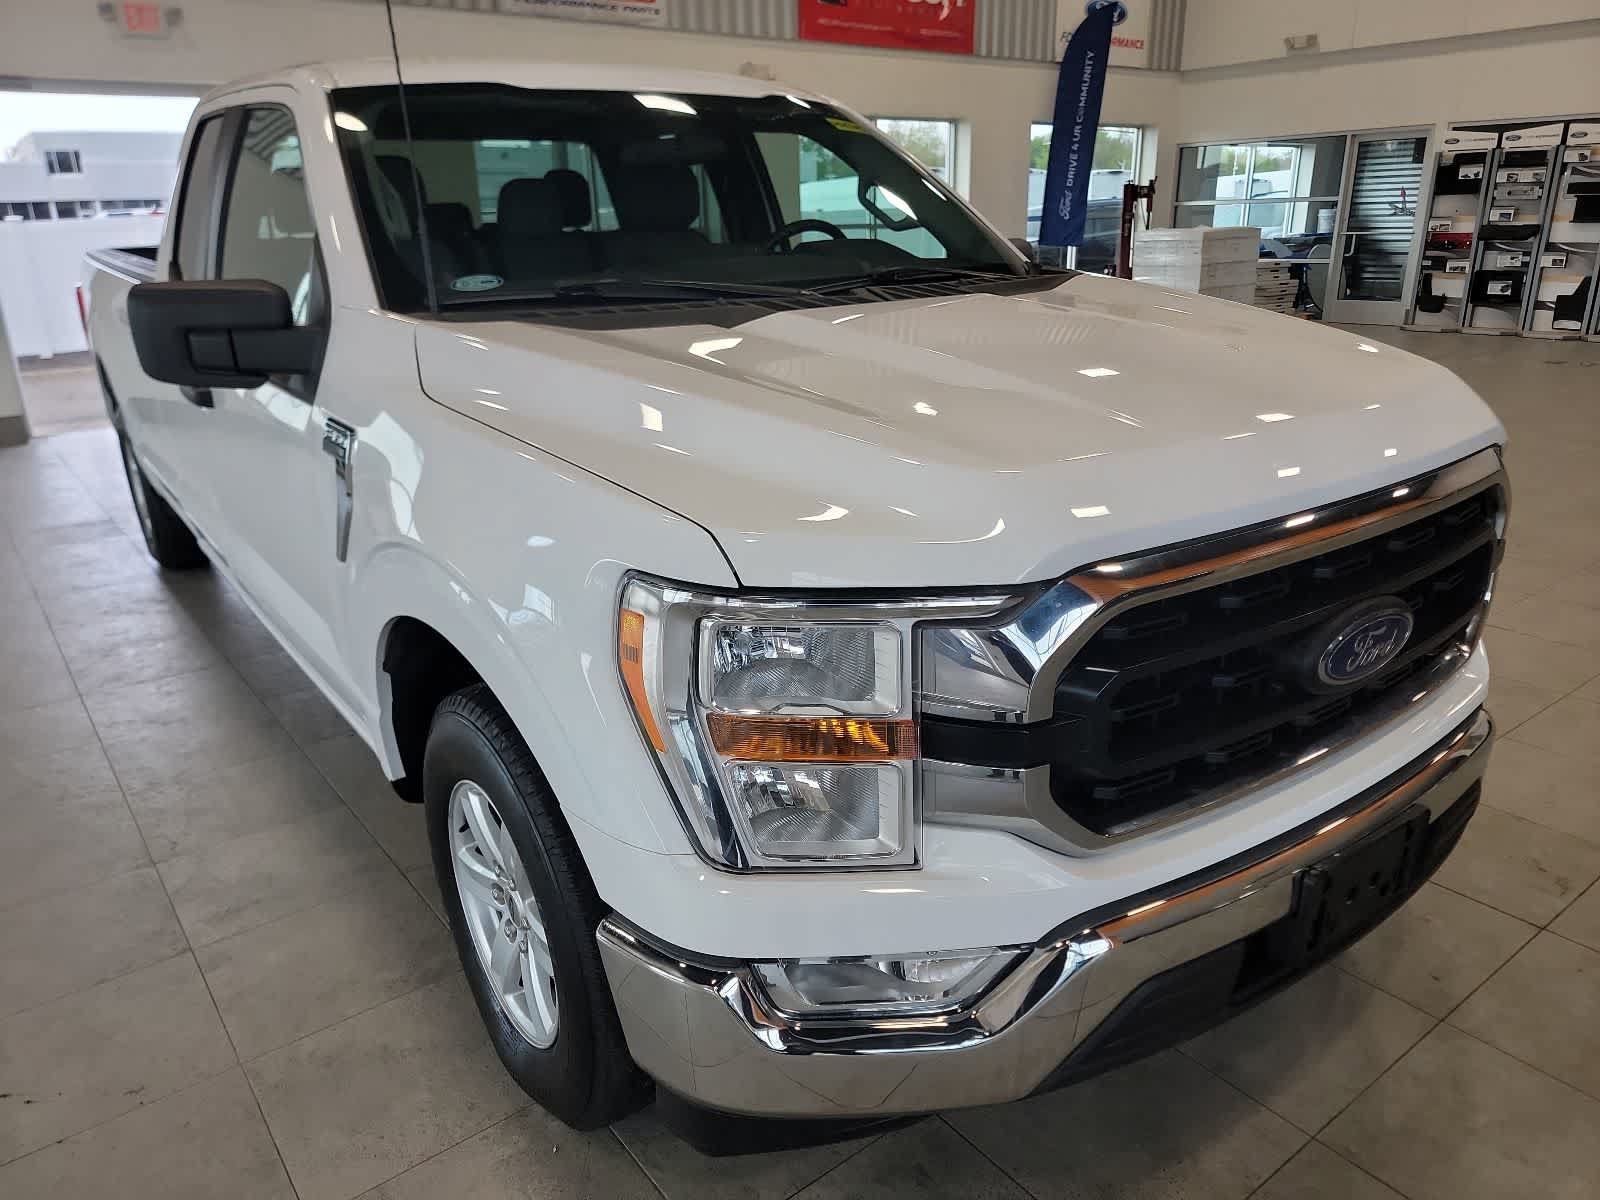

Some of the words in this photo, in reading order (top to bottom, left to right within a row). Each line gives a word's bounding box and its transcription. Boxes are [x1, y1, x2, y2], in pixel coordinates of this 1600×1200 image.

[1075, 50, 1096, 123] COMMUNITY
[1072, 124, 1083, 141] UR
[1066, 152, 1080, 187] DRIVE
[1058, 189, 1073, 220] Ford
[1345, 625, 1402, 672] Ford
